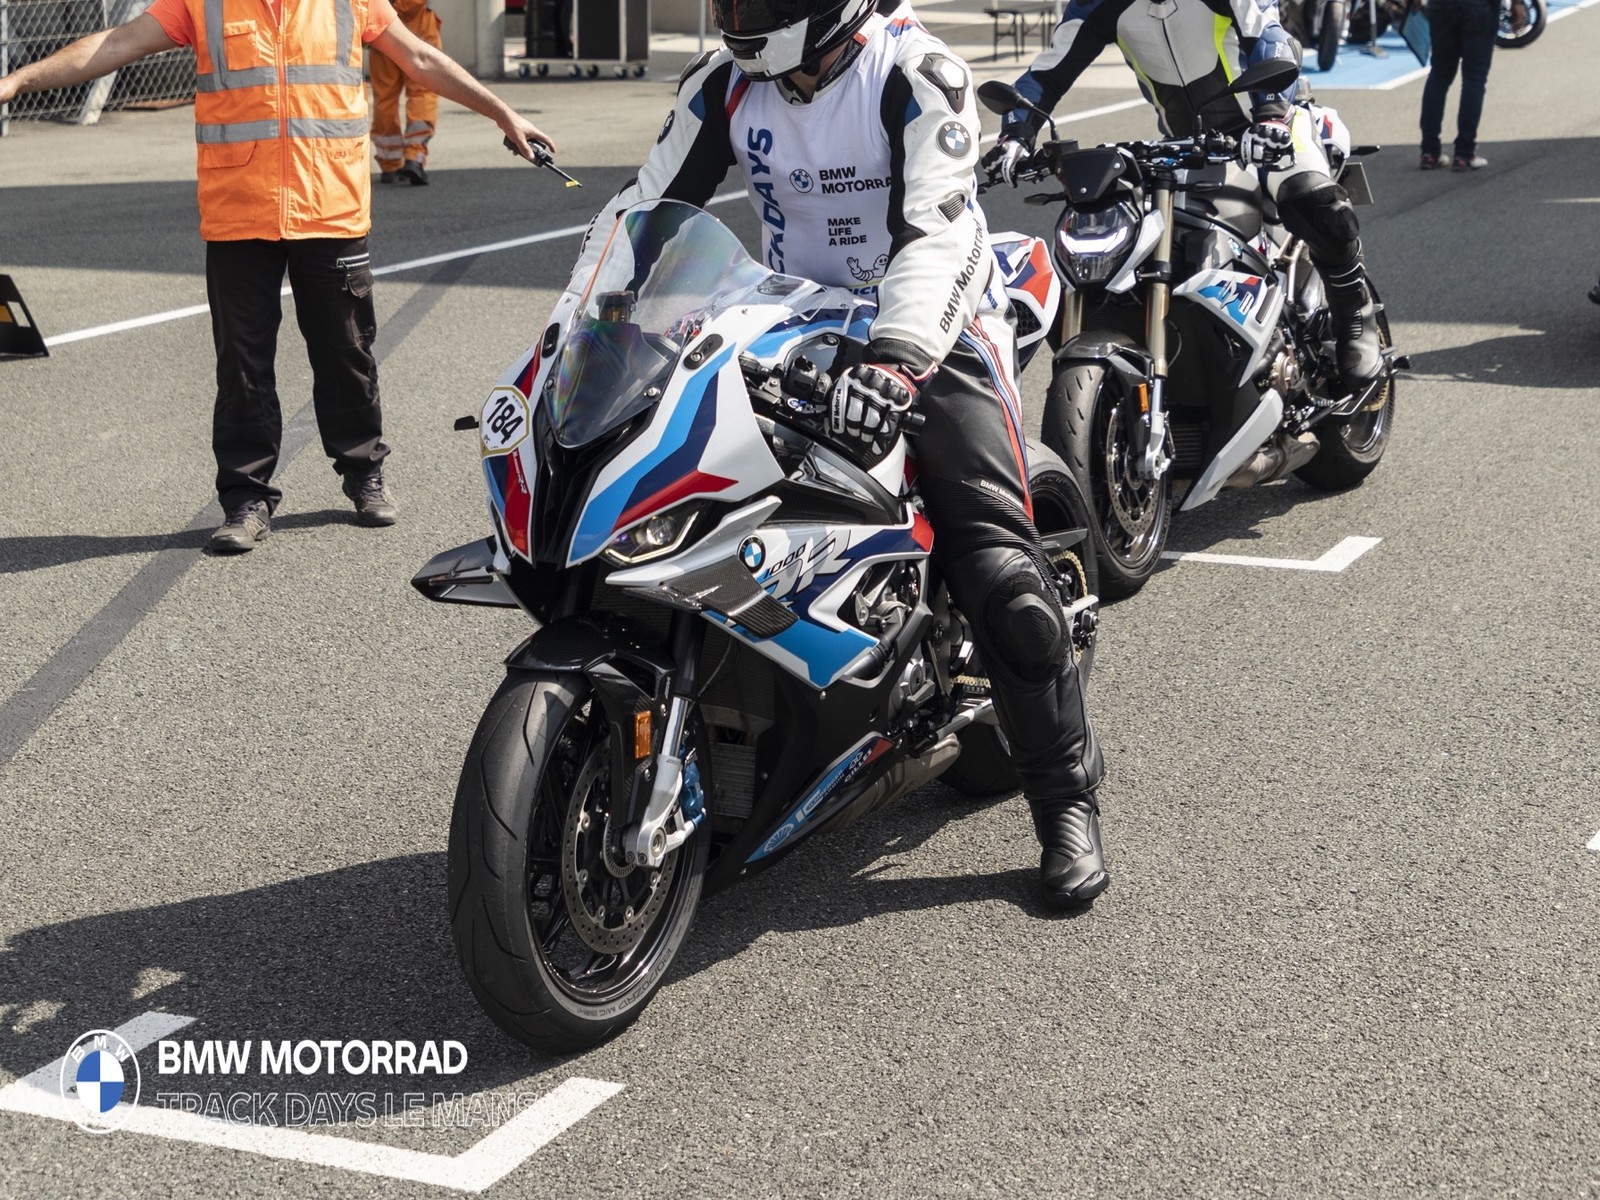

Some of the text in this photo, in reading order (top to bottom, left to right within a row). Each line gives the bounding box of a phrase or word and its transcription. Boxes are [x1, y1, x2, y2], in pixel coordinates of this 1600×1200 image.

[818, 165, 857, 182] BMW
[827, 216, 861, 227] MAKE
[828, 226, 852, 237] LIFE
[828, 234, 867, 247] A RIDE
[939, 220, 985, 335] BMW Motorrad
[486, 395, 524, 446] 184
[980, 479, 1000, 493] BMW
